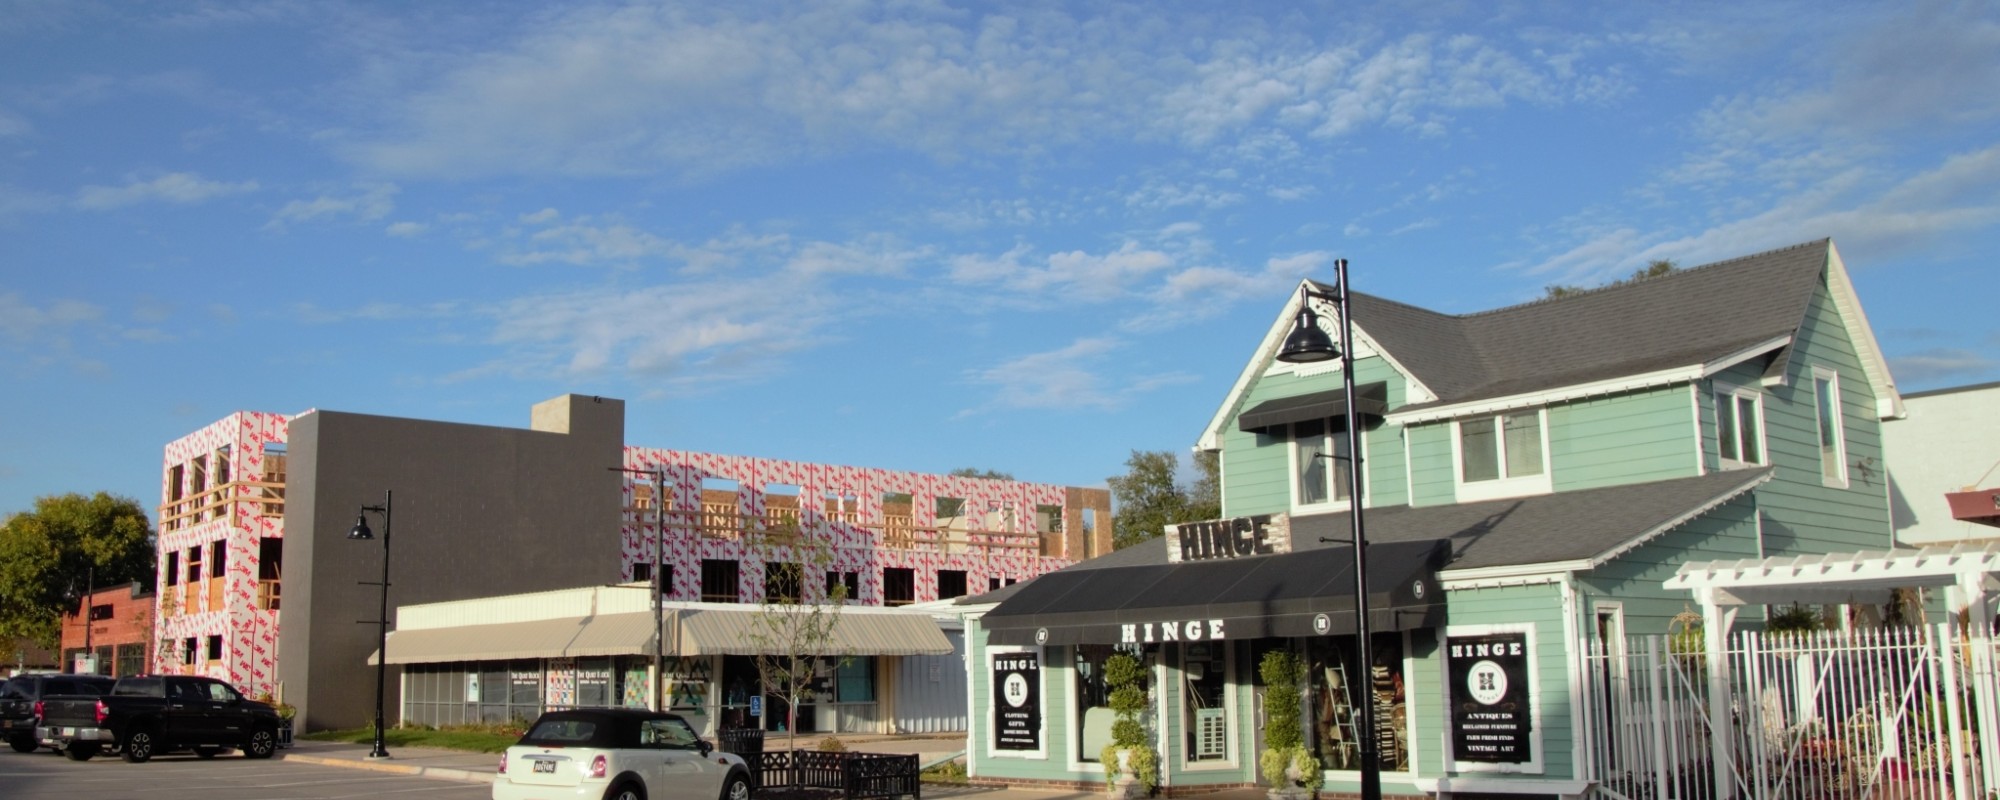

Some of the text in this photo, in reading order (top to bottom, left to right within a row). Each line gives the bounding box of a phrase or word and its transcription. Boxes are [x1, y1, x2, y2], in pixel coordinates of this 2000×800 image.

[1178, 514, 1274, 560] HINGE
[1122, 620, 1225, 643] HINGE
[1452, 643, 1521, 657] HINGE
[996, 660, 1037, 670] HINGE
[1011, 682, 1020, 696] H
[1478, 672, 1495, 690] H
